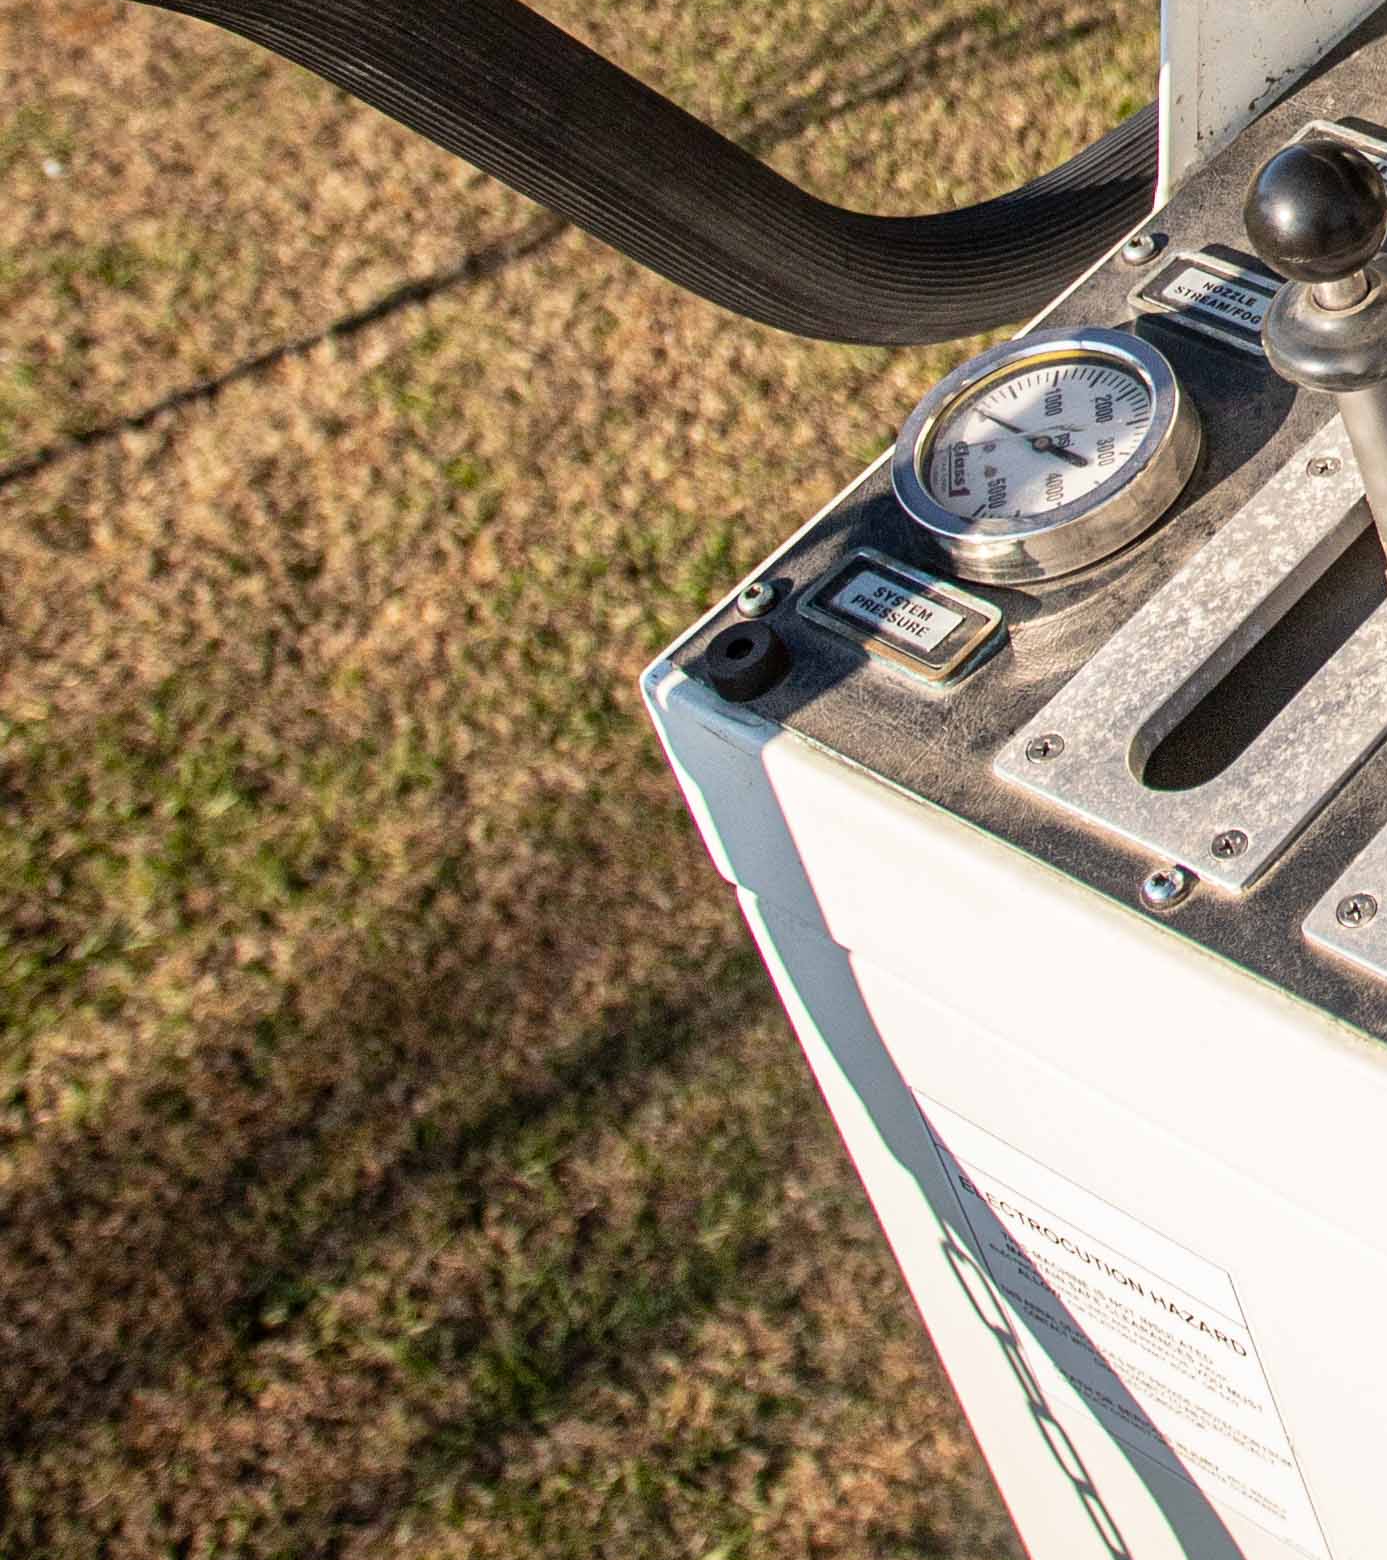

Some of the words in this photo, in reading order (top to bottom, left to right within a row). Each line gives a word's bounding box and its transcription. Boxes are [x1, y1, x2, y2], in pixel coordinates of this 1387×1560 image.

[1173, 285, 1263, 326] STREAM/FOG
[1202, 281, 1258, 308] NOZZLE
[1045, 387, 1063, 417] 1000
[1094, 394, 1114, 424] 2000
[1054, 432, 1075, 449] psi
[1096, 436, 1116, 466] 3000
[987, 477, 1007, 509] 5000
[1046, 472, 1065, 502] 4000
[850, 594, 931, 638] PRESSURE
[873, 586, 934, 622] SYSTEM
[1150, 1291, 1247, 1357] HAZARD
